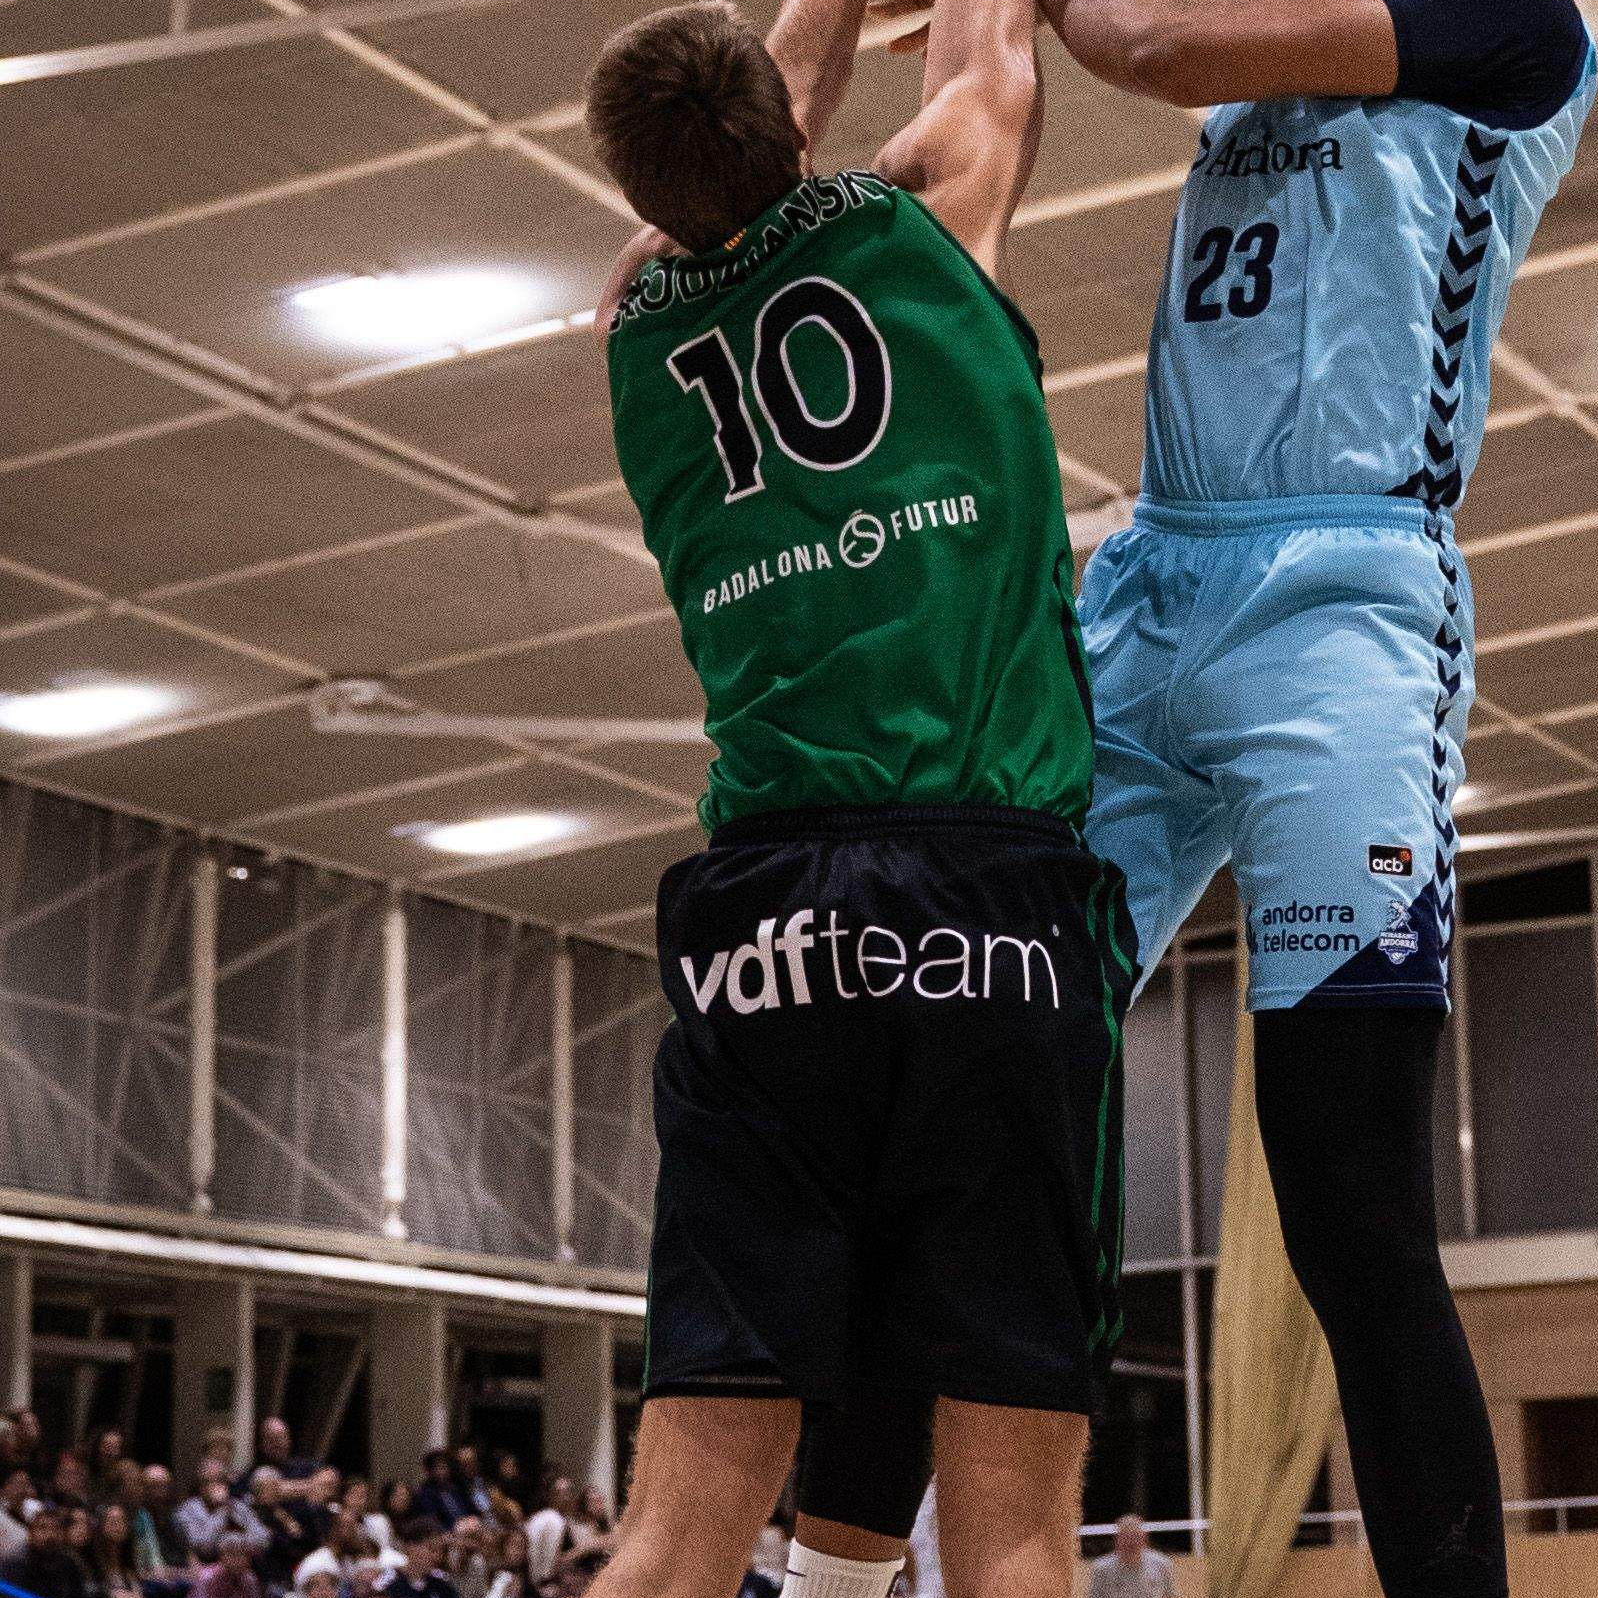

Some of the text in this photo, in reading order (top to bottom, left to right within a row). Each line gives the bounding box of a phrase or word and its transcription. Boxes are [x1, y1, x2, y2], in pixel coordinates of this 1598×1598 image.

[1184, 222, 1280, 323] 23
[666, 275, 892, 504] 10
[703, 494, 978, 613] BADALONA FUTUR
[1372, 857, 1404, 874] acb
[1262, 900, 1355, 925] andorra
[1264, 929, 1360, 953] telecom
